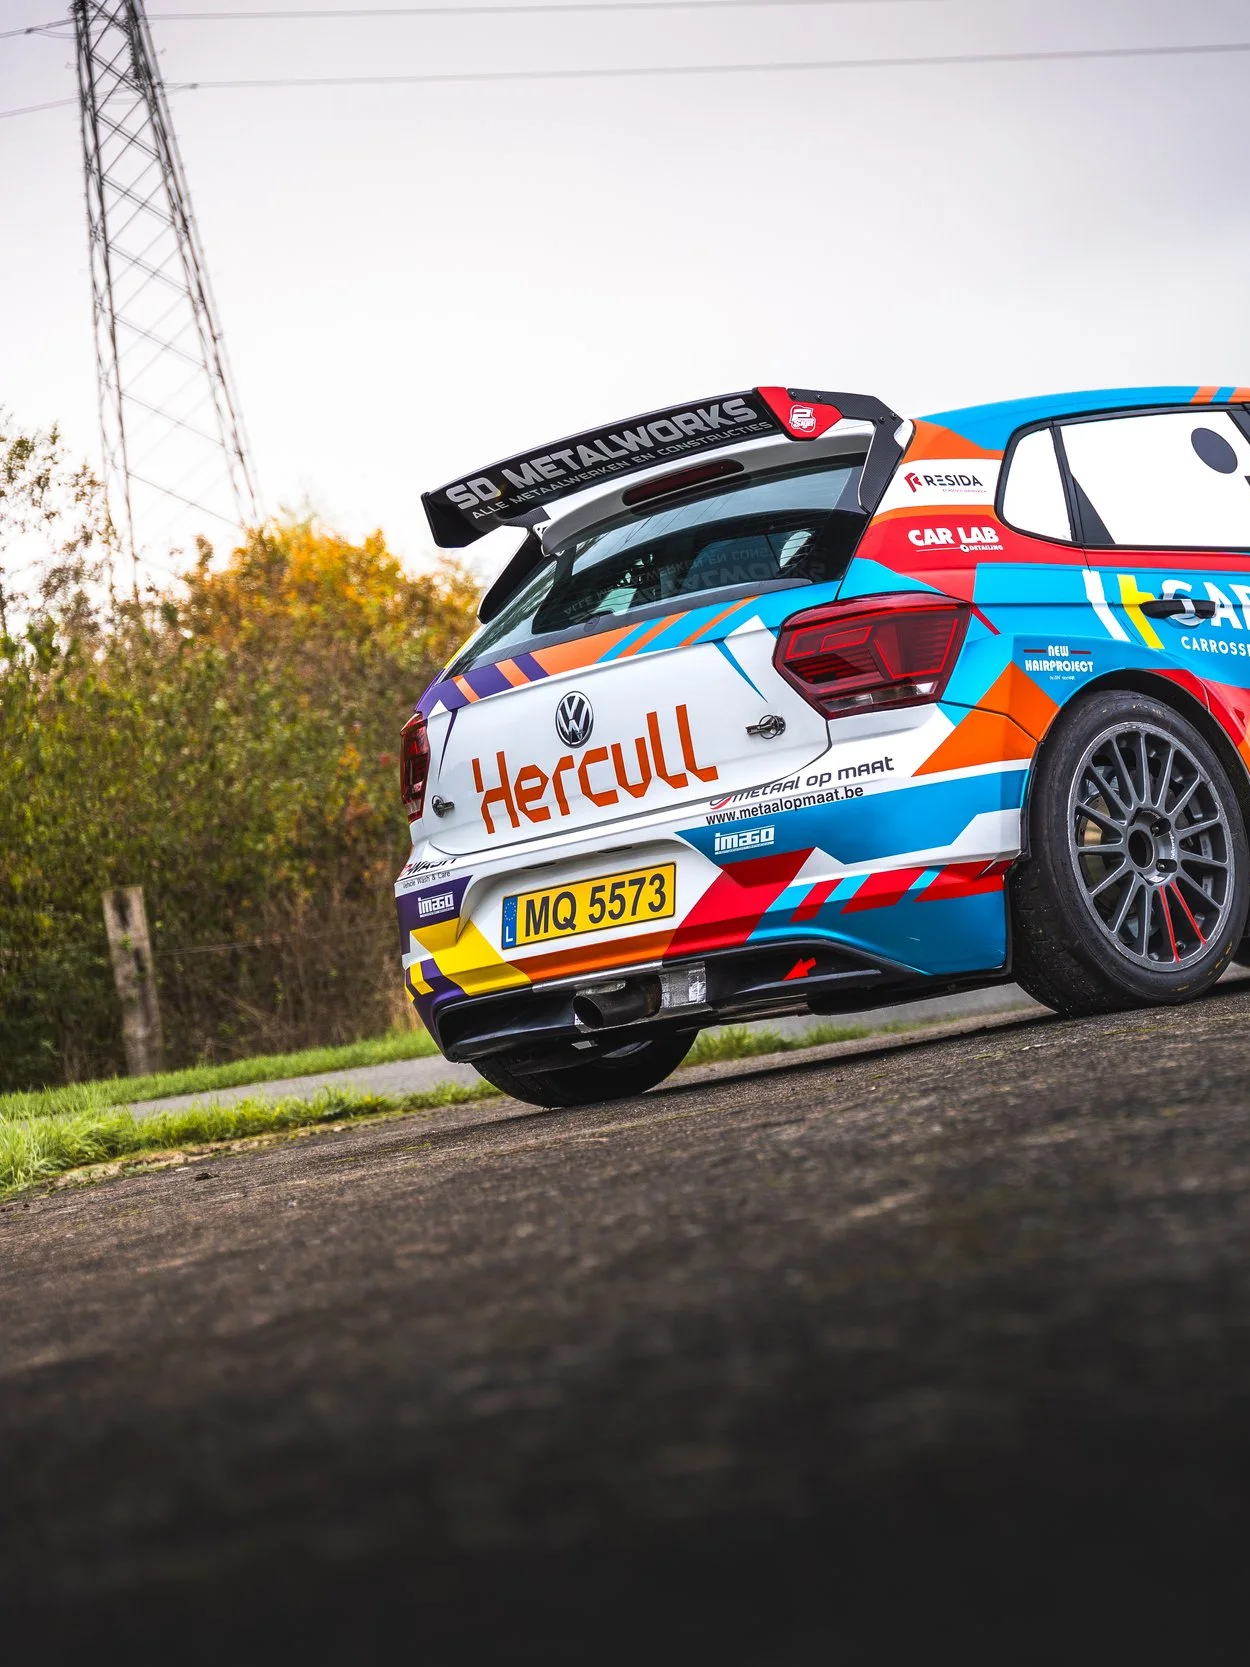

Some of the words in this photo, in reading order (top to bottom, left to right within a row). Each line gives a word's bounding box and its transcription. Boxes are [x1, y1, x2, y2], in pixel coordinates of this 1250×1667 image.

[445, 477, 502, 510] SD
[501, 398, 758, 489] METALWORKS
[472, 500, 510, 520] ALLE
[509, 460, 632, 504] METAALWERKEN
[634, 452, 657, 464] EN
[658, 421, 773, 456] CONSTRUCTIES
[923, 474, 984, 487] RESIDA
[907, 527, 956, 547] CAR
[956, 526, 1000, 544] LAB
[1047, 645, 1069, 657] NEW
[1024, 659, 1094, 673] HAIRPROJECT
[471, 703, 719, 835] Hercull
[806, 771, 832, 788] op
[705, 786, 864, 826] www.metaalopmaat.be
[525, 890, 577, 938] MQ
[588, 873, 667, 924] 5573
[505, 925, 514, 943] L
